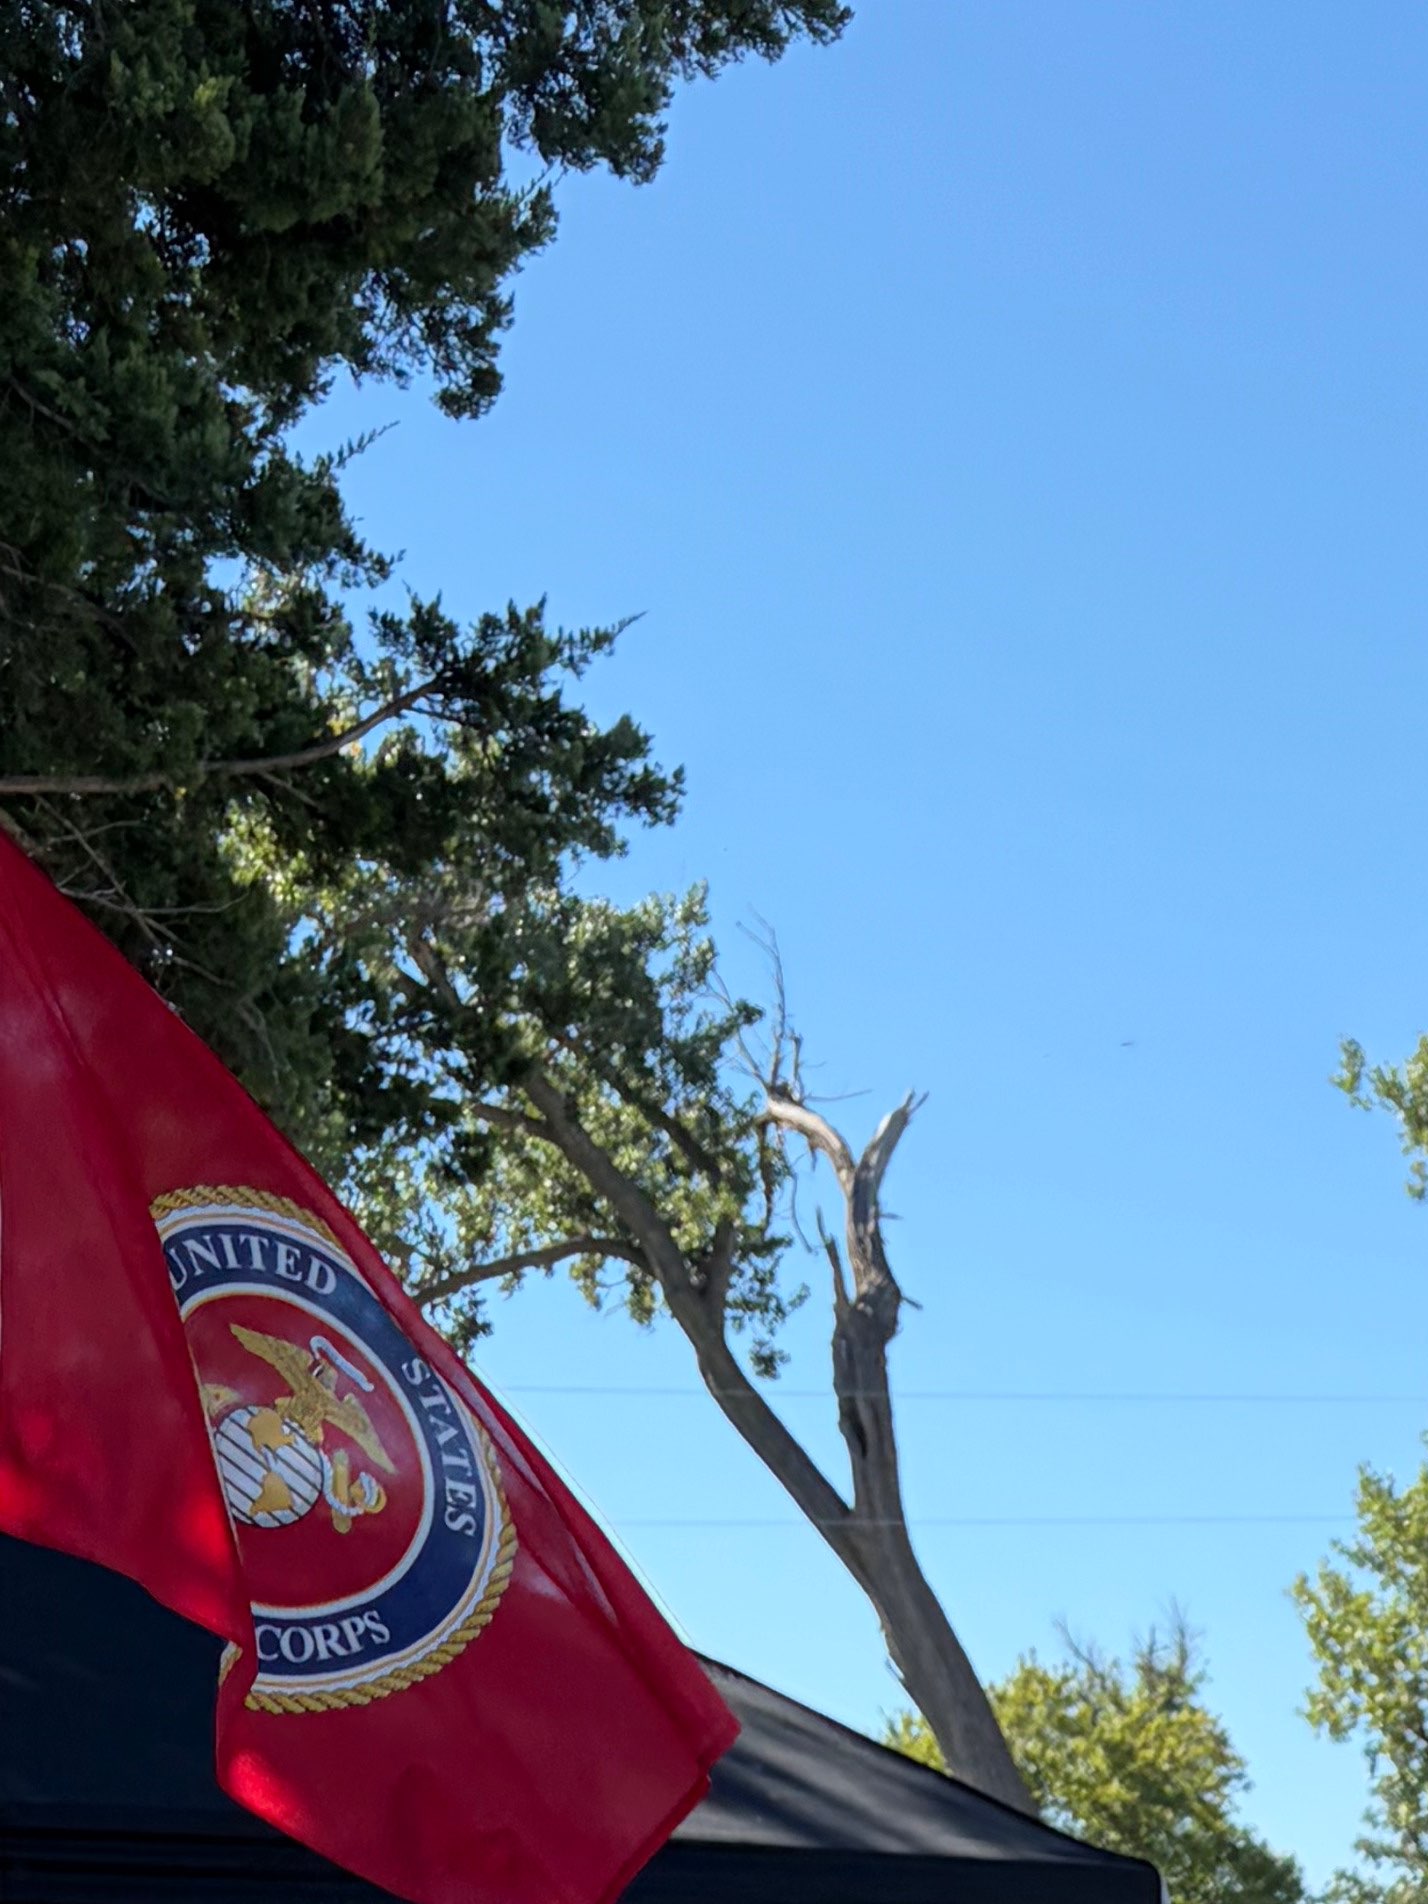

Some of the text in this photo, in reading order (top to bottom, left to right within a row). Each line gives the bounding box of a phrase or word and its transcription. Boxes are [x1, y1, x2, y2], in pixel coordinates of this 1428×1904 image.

[169, 1232, 337, 1296] UNITED
[401, 1357, 477, 1537] STATES
[255, 1609, 391, 1664] CORPS
